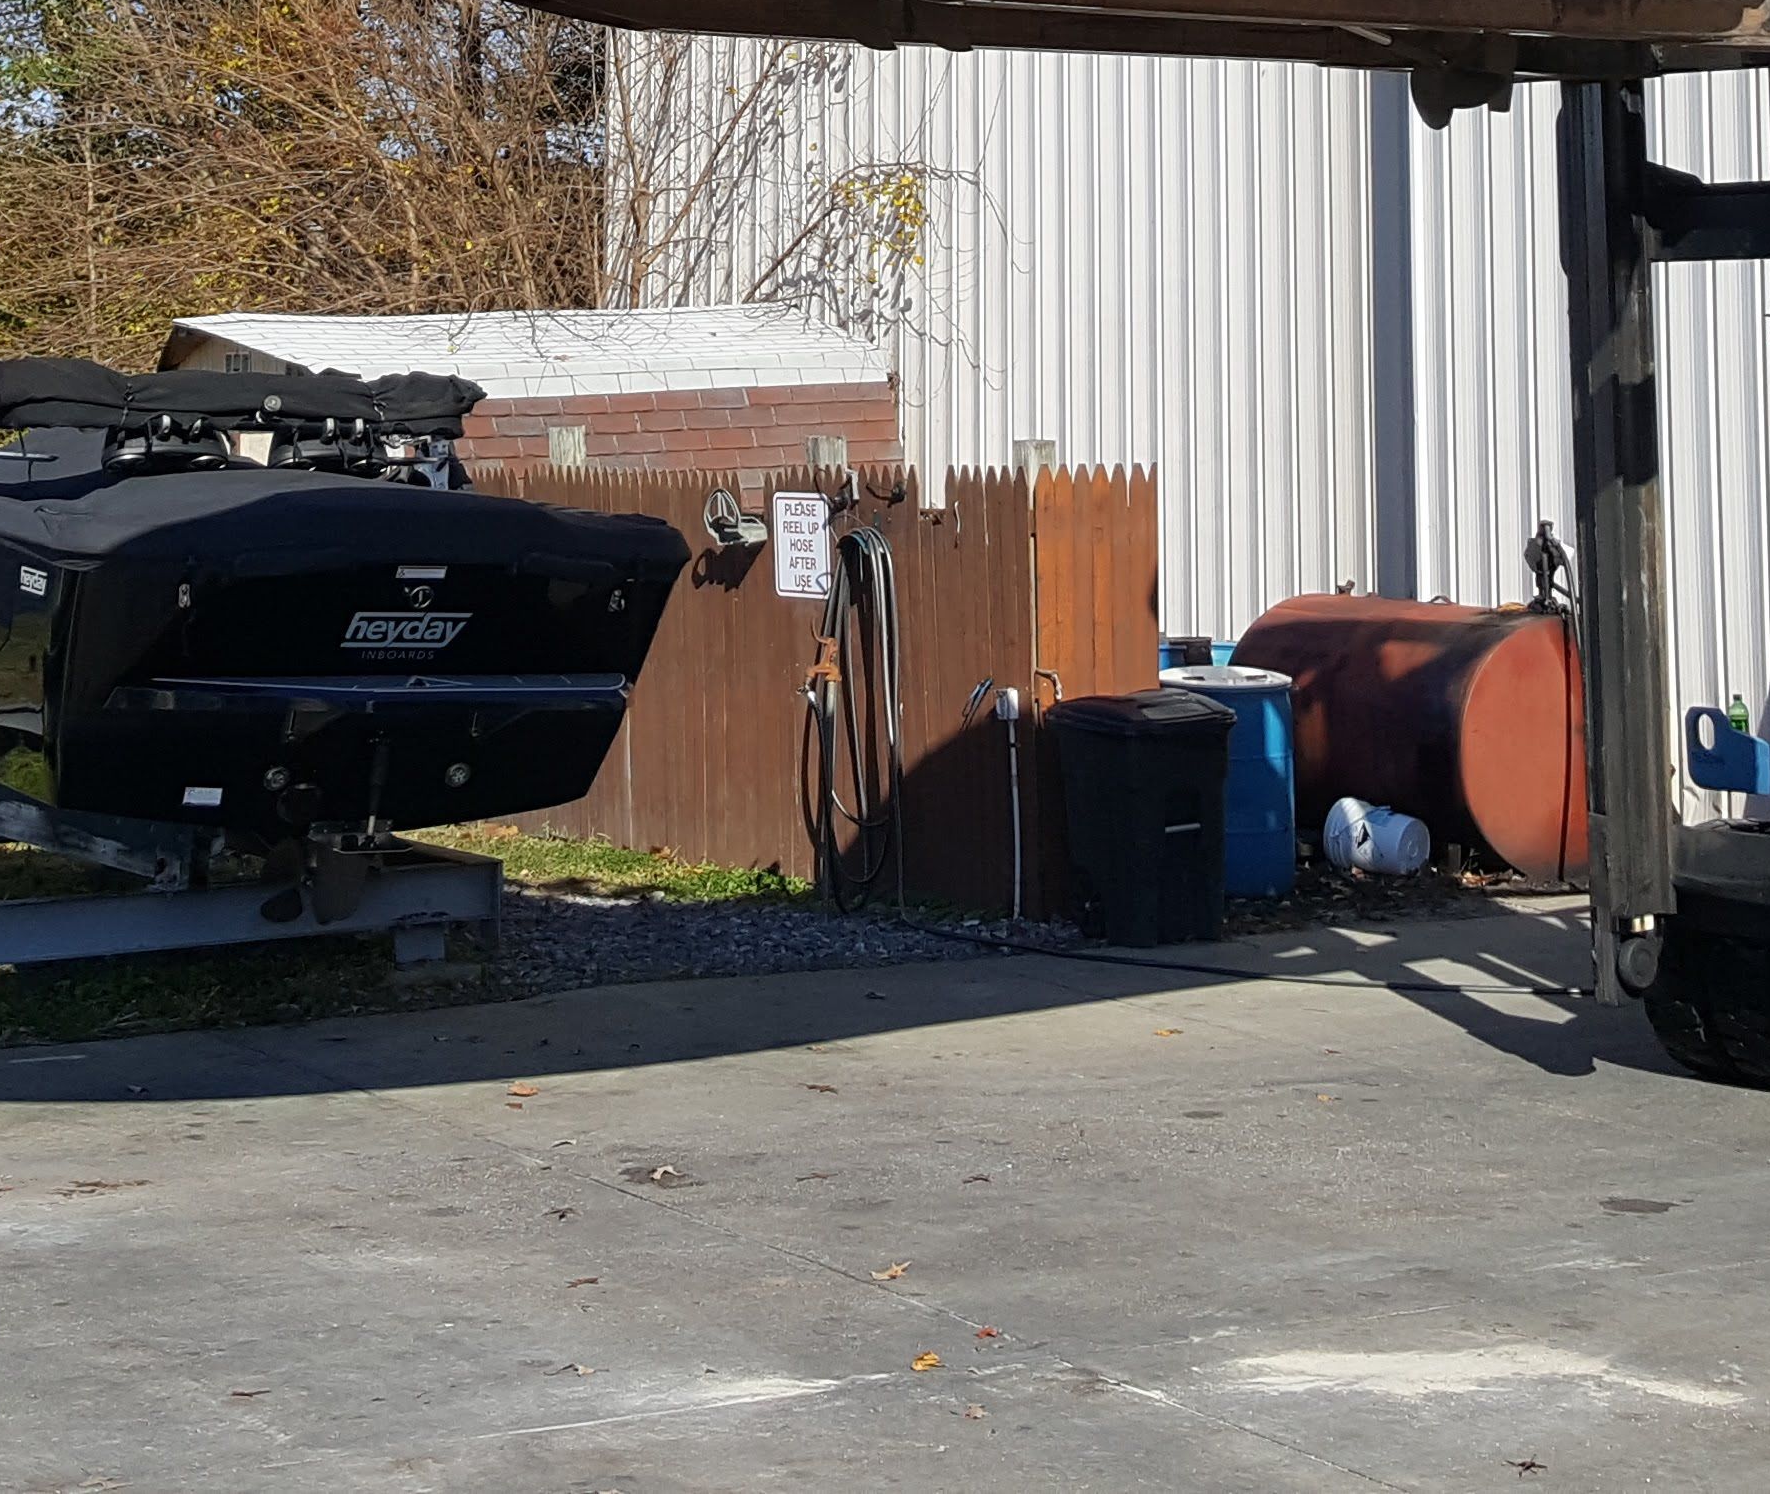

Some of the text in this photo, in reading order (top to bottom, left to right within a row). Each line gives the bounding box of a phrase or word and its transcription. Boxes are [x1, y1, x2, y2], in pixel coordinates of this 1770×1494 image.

[784, 503, 817, 517] PLEASE
[783, 520, 819, 535] REEL UP
[789, 538, 814, 552] HOSE
[789, 556, 816, 570] AFTER
[794, 574, 812, 588] USE
[340, 612, 473, 647] heyday
[361, 650, 435, 660] INBOARDS
